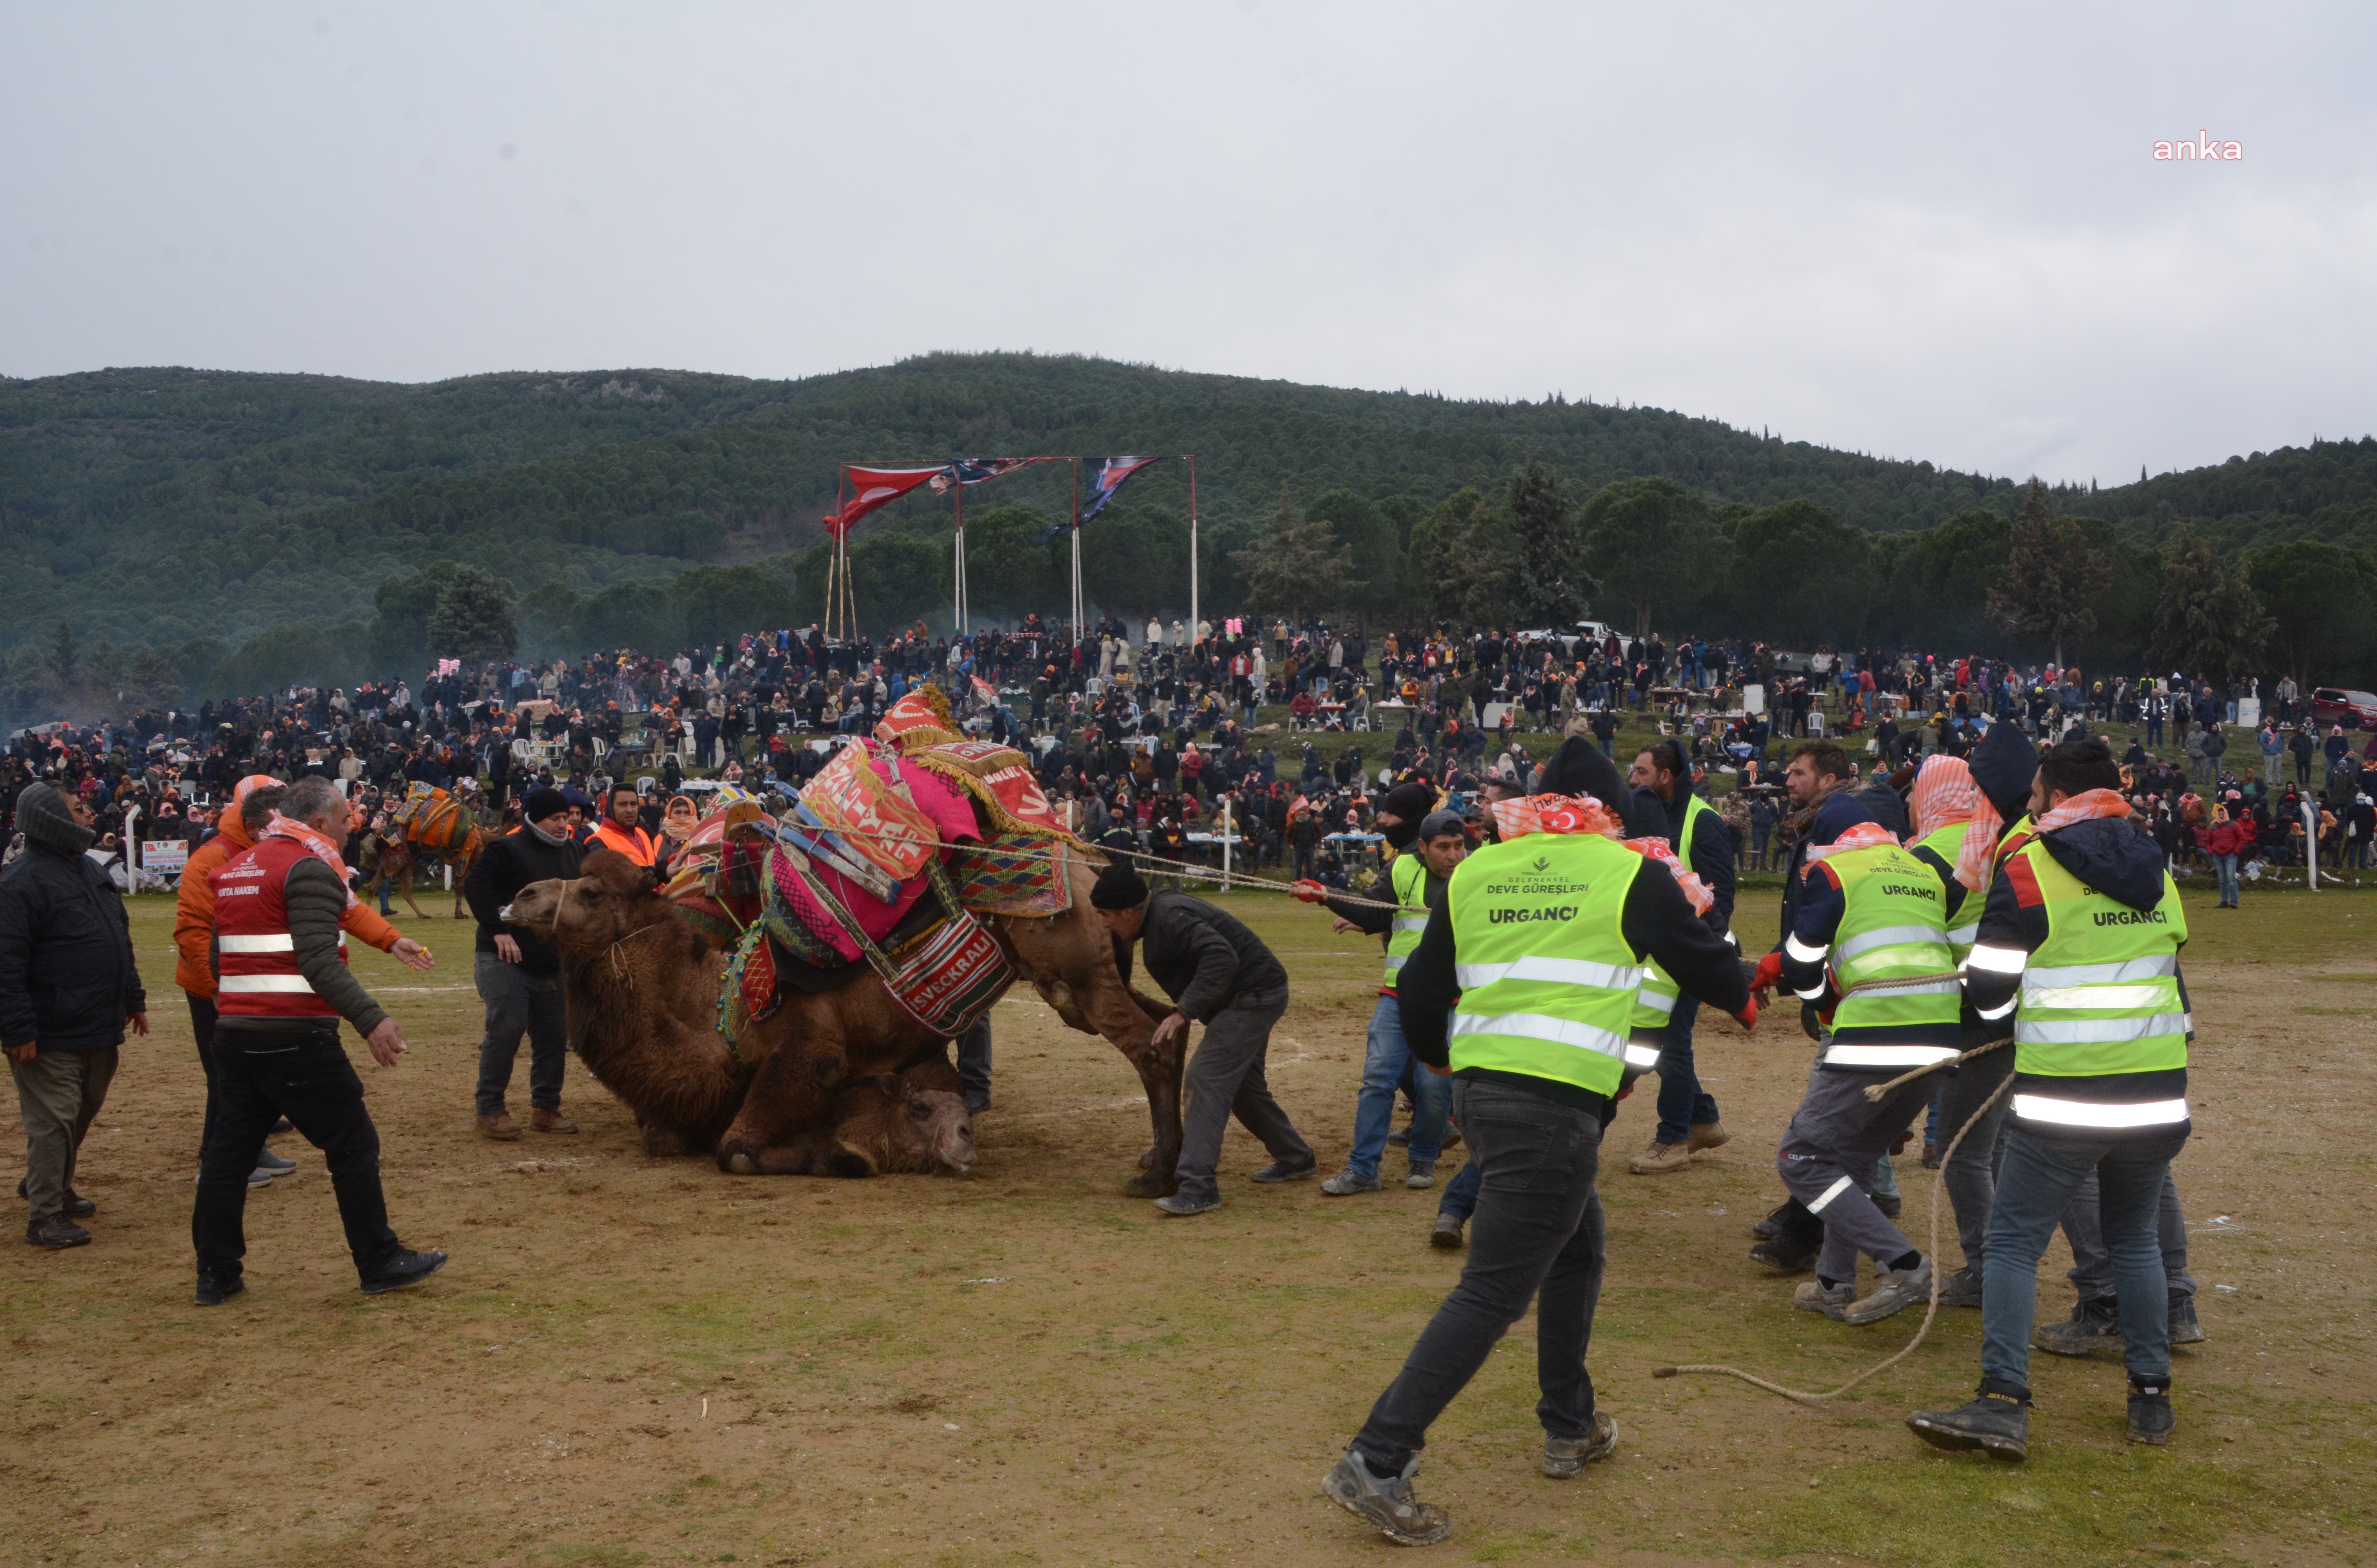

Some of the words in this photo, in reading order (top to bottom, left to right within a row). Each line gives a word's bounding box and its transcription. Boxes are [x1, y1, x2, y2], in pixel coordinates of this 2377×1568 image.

[1881, 862, 1918, 871] GELENEKSEL
[218, 887, 233, 897] ORTA
[234, 886, 259, 895] HAKEM
[1487, 885, 1519, 894] DEVE
[1522, 884, 1589, 894] GÜREŞLERİ
[1882, 885, 1935, 901] URGANCI
[1489, 906, 1578, 924] URGANCI
[2093, 911, 2167, 926] URGANCI
